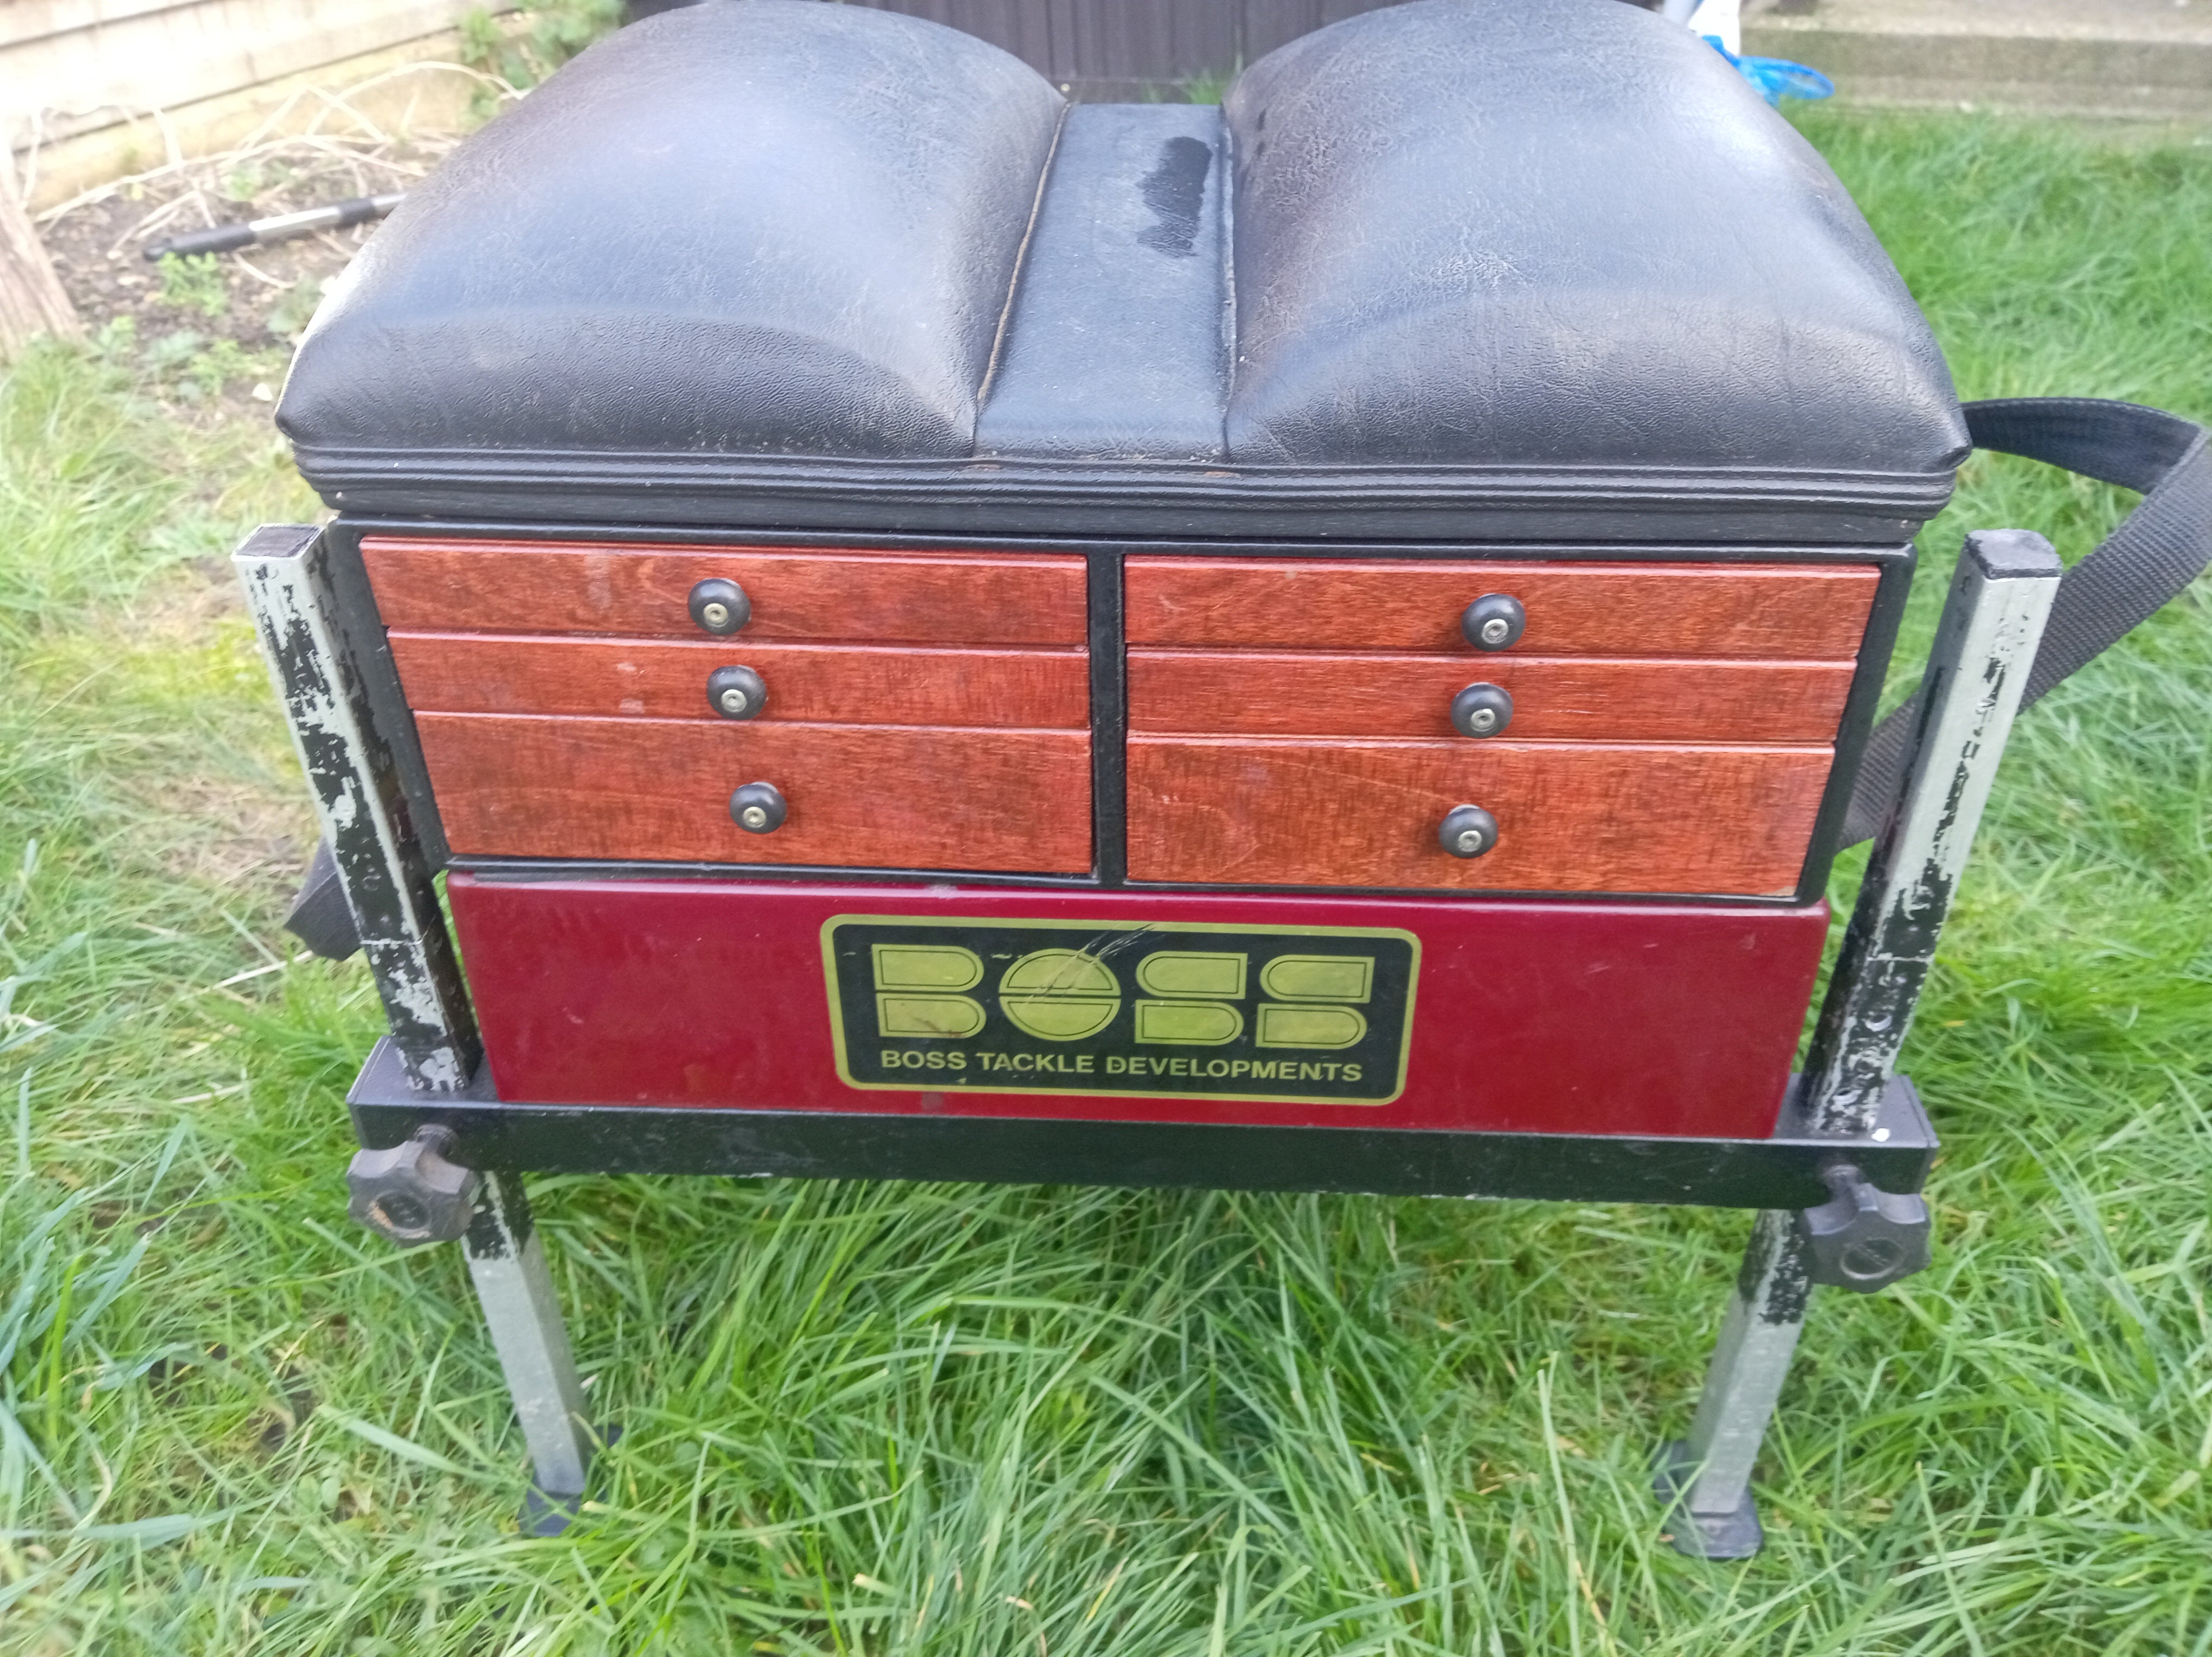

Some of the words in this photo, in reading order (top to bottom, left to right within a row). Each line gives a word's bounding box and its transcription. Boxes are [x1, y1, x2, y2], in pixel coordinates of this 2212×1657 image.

[871, 943, 1375, 1049] BOSS
[881, 1050, 967, 1069] BOSS
[976, 1052, 1094, 1074] TACKLE
[1106, 1056, 1362, 1082] DEVELOPMENTS
